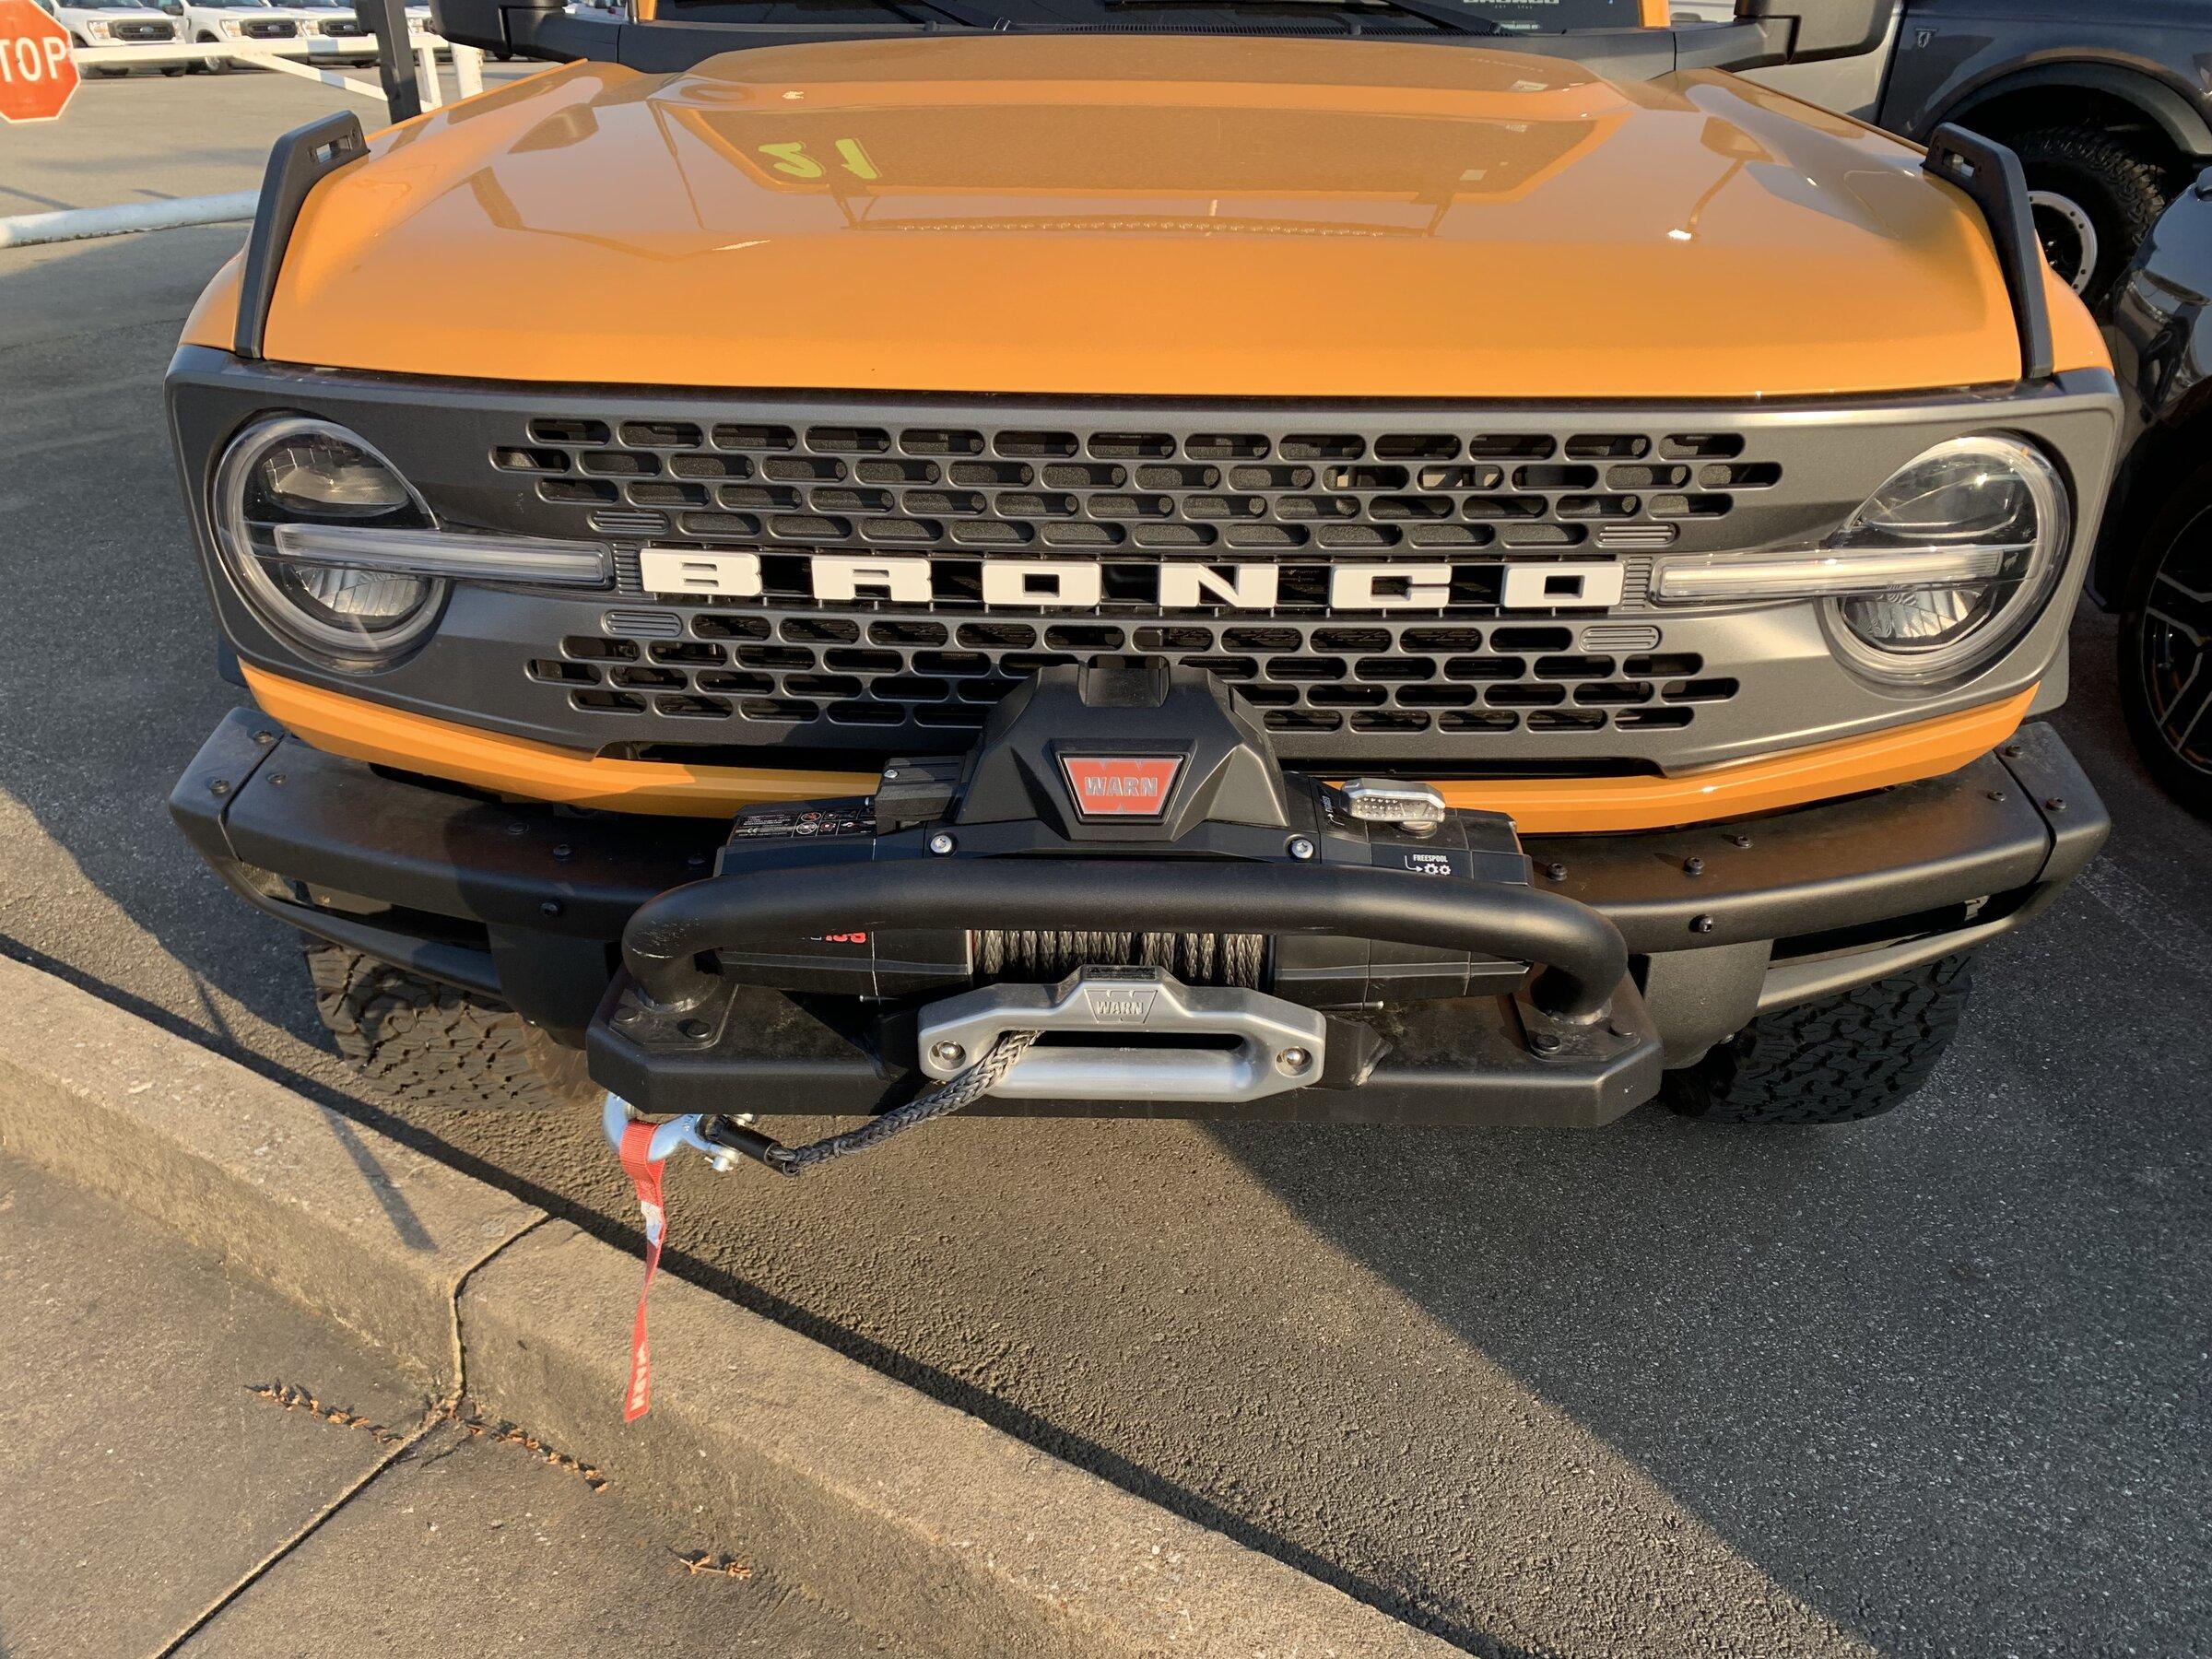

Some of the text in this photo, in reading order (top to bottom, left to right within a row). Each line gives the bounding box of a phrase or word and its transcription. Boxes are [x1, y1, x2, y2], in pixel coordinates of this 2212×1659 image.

[0, 36, 67, 83] TOP
[640, 548, 1625, 608] BRONCO
[1084, 776, 1158, 797] WARN
[1413, 853, 1449, 863] FREESPOOL
[1097, 1001, 1144, 1015] WARN
